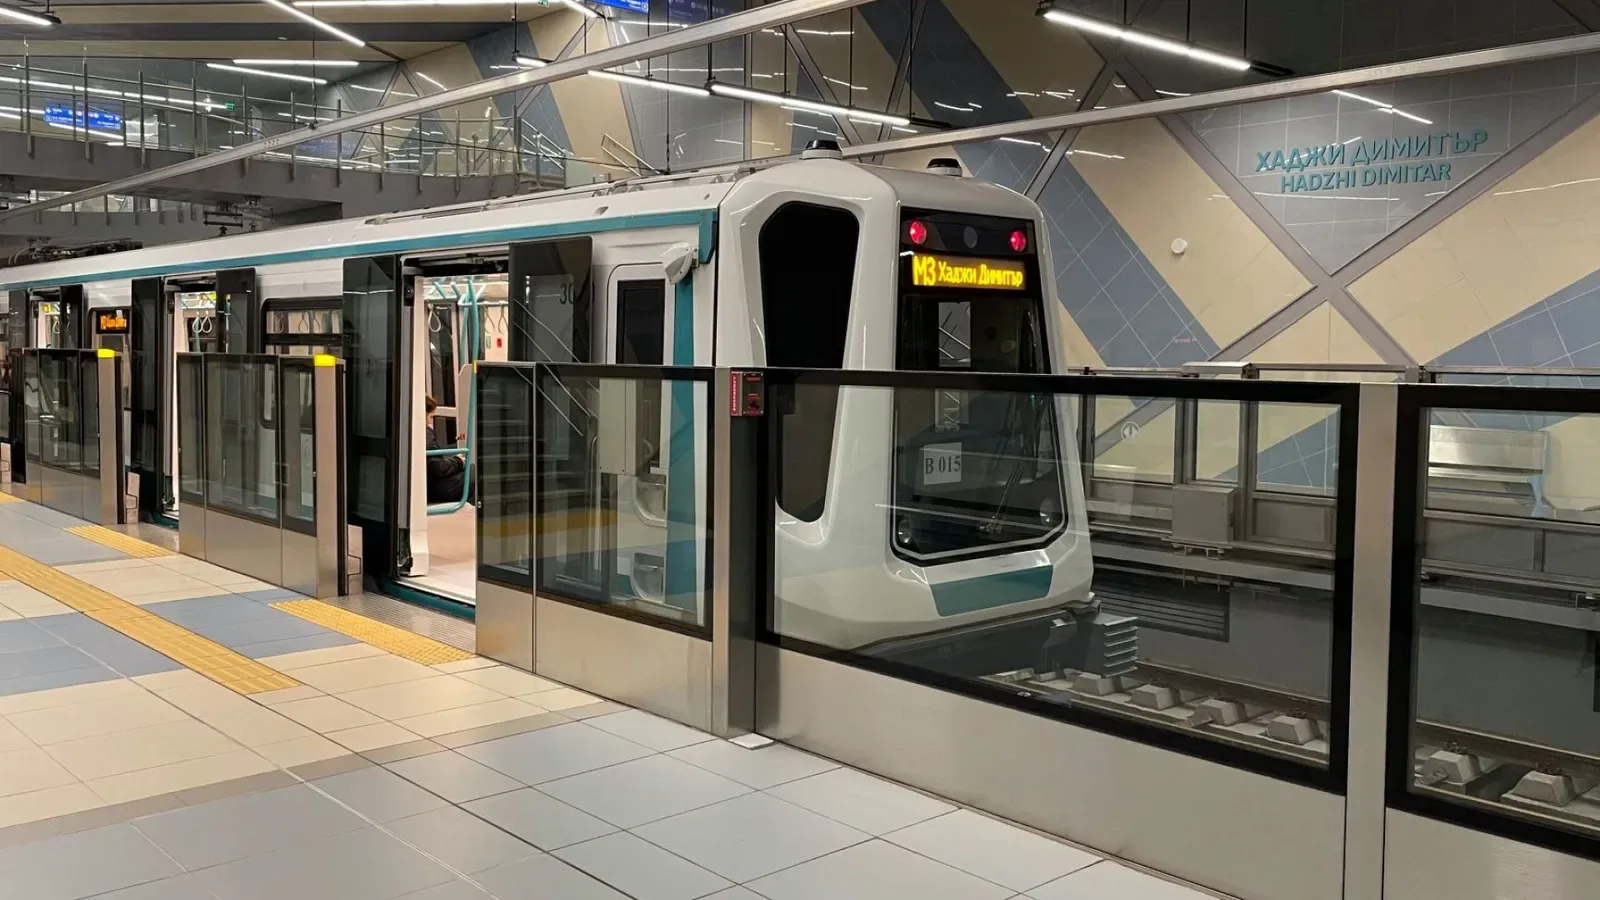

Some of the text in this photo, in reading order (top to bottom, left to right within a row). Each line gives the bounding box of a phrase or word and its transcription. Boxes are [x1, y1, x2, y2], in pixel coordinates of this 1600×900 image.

[1255, 128, 1488, 172] ХАДЖИ ДИМИТЪР
[1281, 163, 1451, 193] HADZHI DIMITAR
[938, 261, 976, 283] Хаджи
[978, 264, 1023, 287] Димитър
[938, 455, 961, 474] 015
